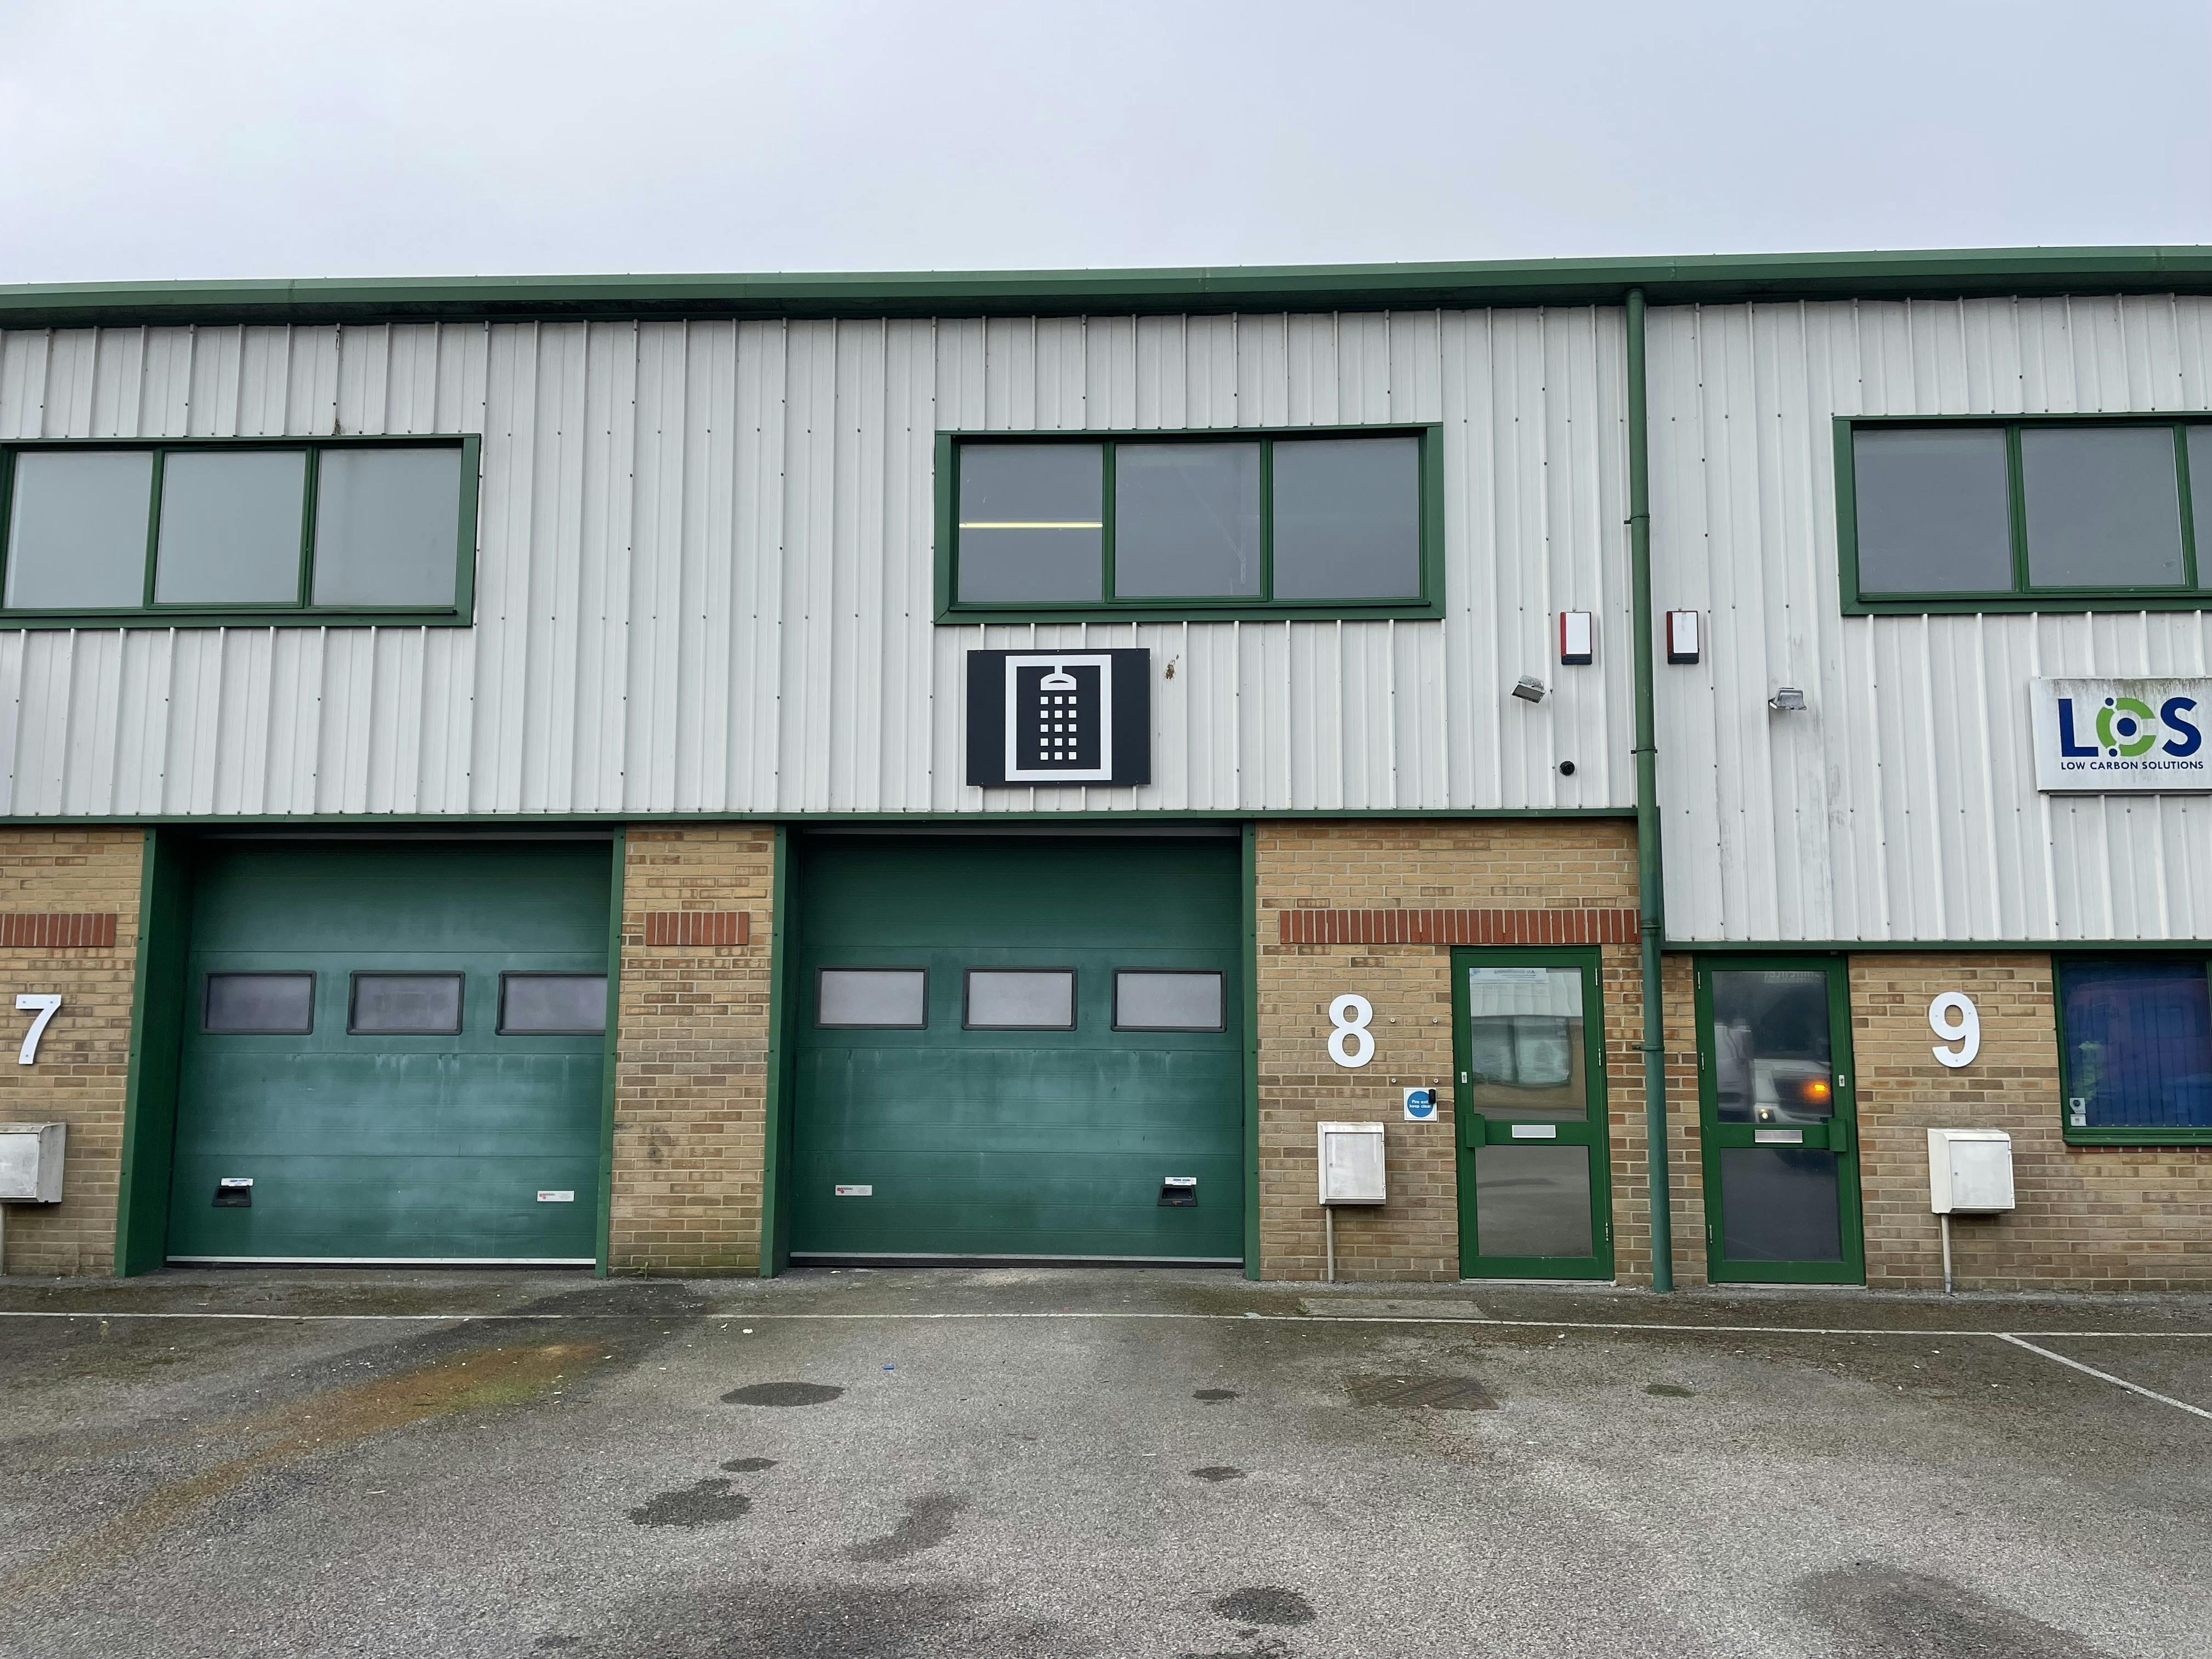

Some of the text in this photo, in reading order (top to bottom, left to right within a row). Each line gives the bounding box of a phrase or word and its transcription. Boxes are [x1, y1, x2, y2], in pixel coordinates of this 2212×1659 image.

[2058, 697, 2202, 757] LCS
[2061, 760, 2204, 770] LOW CARBON SOLUTIONS
[15, 994, 62, 1065] 7
[1327, 994, 1375, 1068] 8
[1928, 991, 1980, 1068] 9
